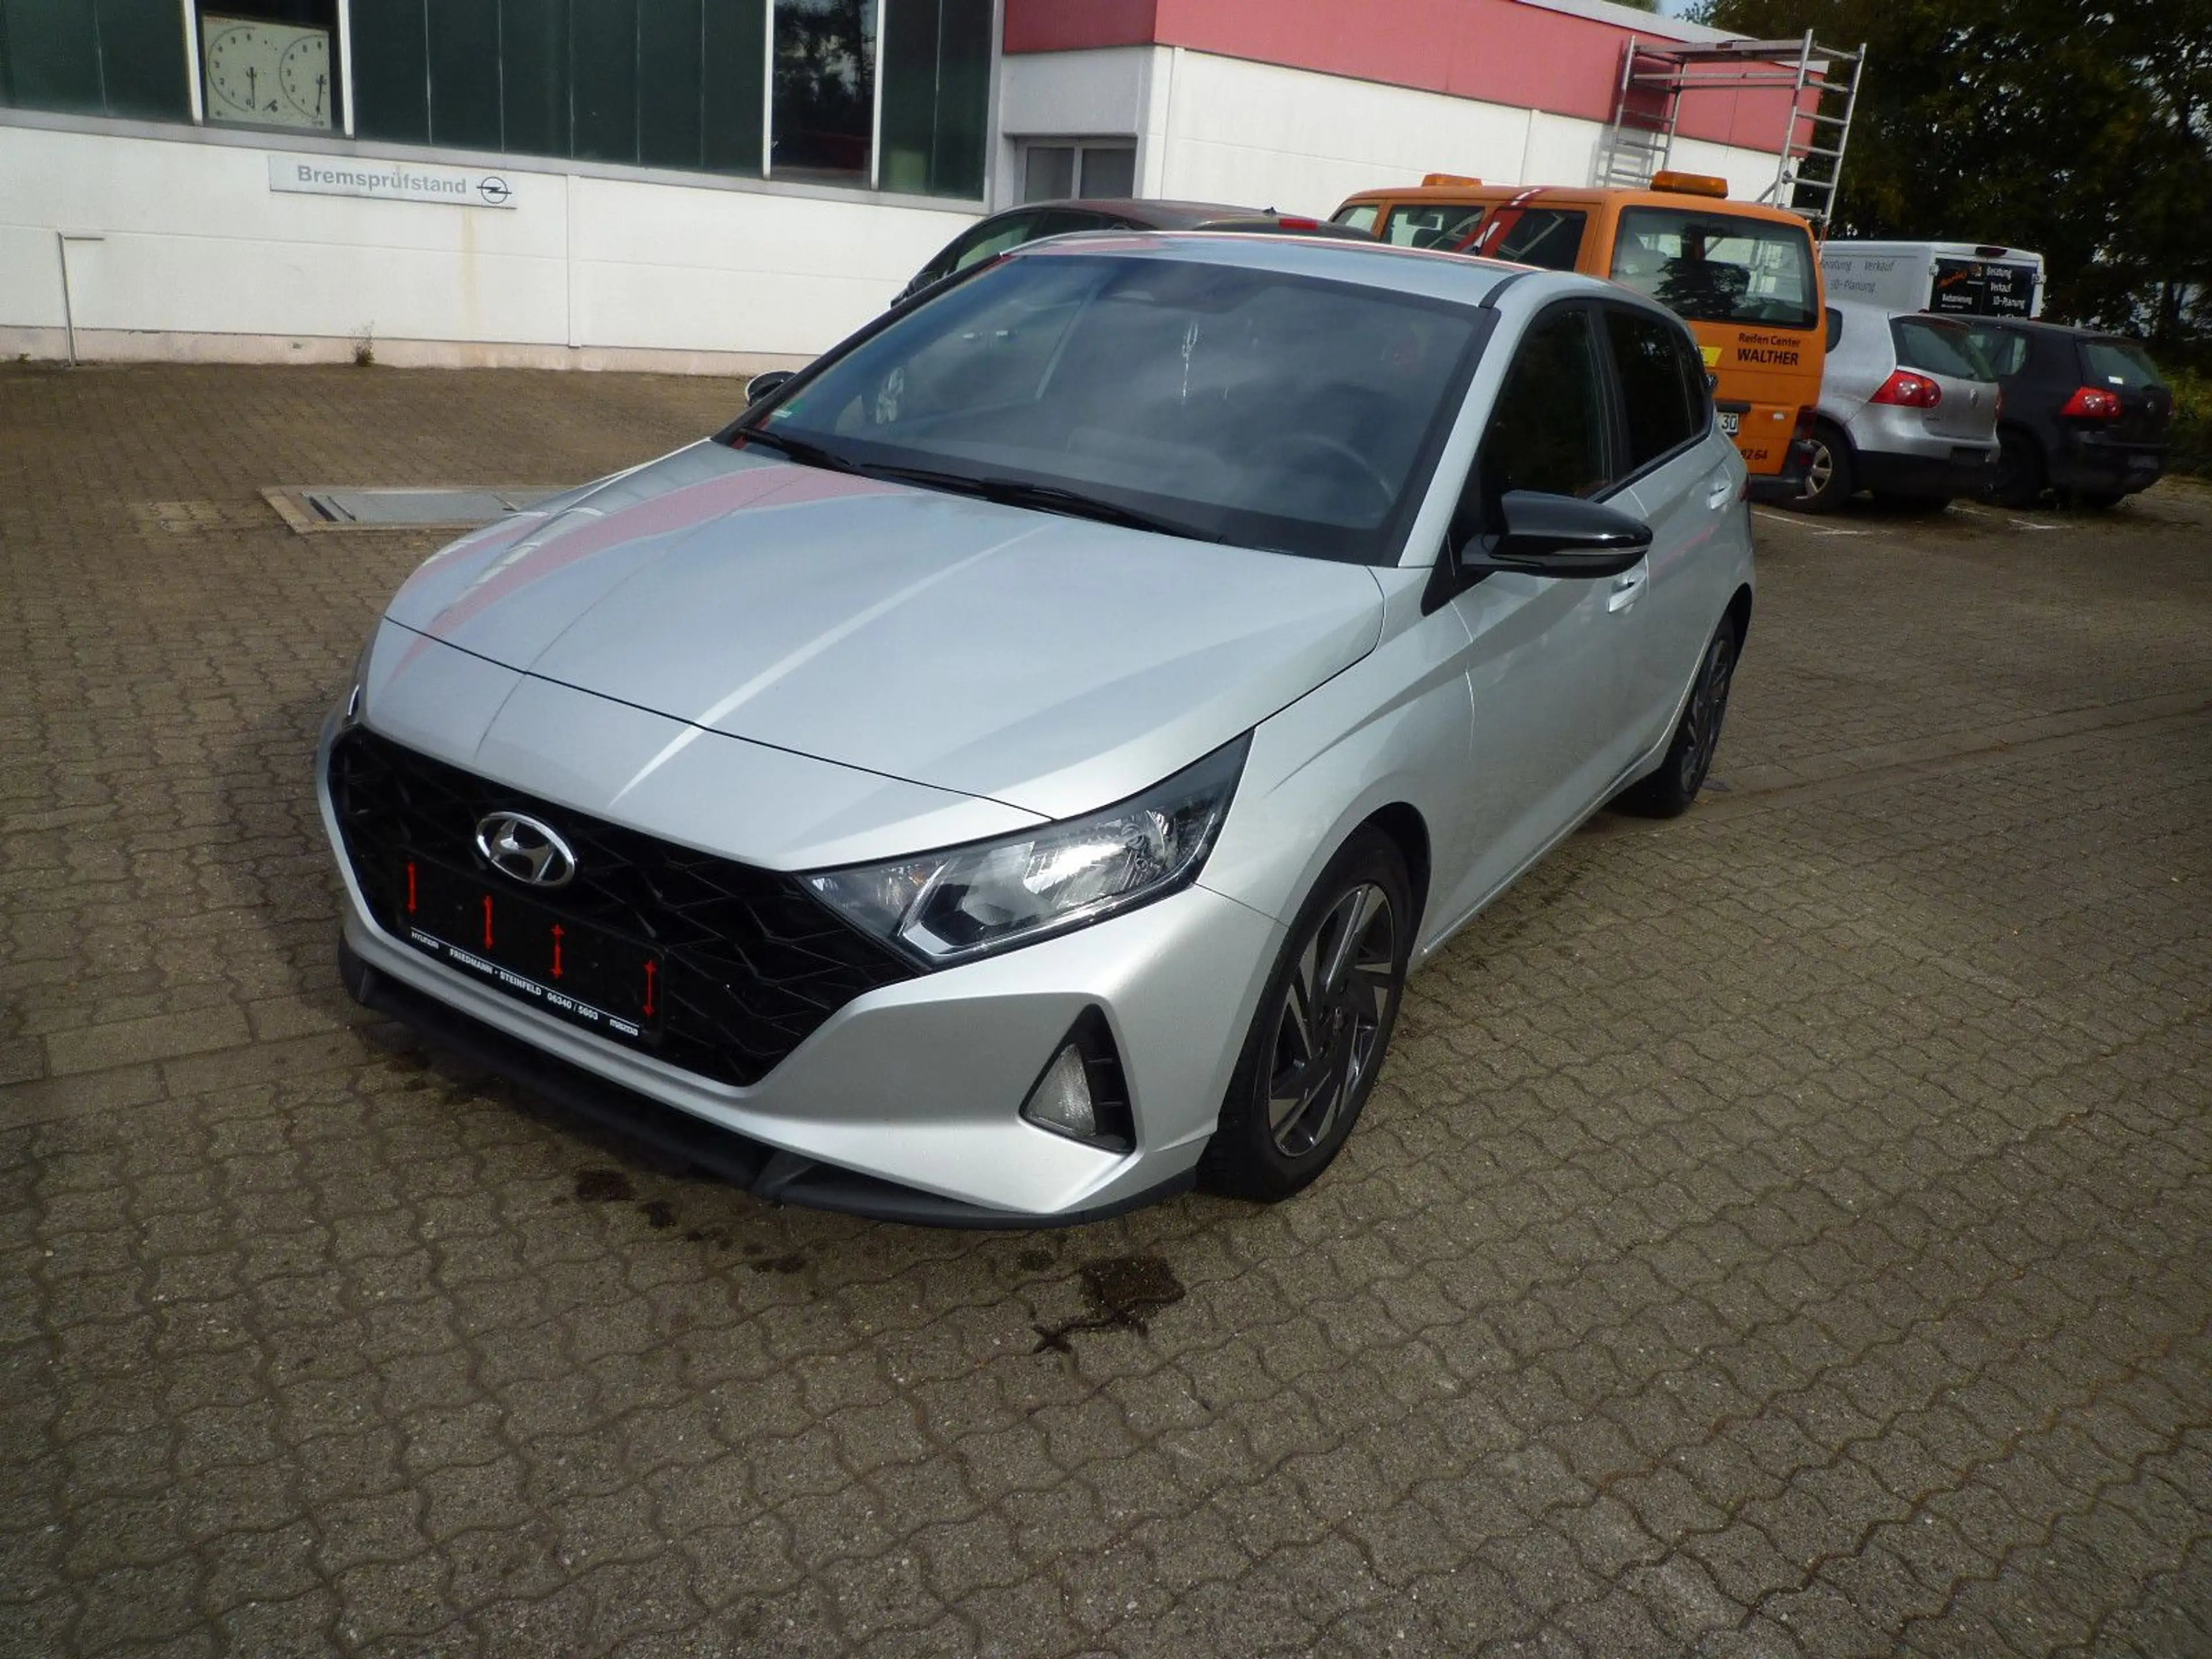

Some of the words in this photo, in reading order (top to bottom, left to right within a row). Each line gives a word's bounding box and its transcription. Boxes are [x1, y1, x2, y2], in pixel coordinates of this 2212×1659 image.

[297, 165, 467, 194] Bremsprüfstand
[1771, 335, 1801, 347] Center
[1737, 348, 1799, 366] WALTHER
[449, 948, 494, 975] FRIEDMANN
[500, 971, 542, 996] STEINFELD
